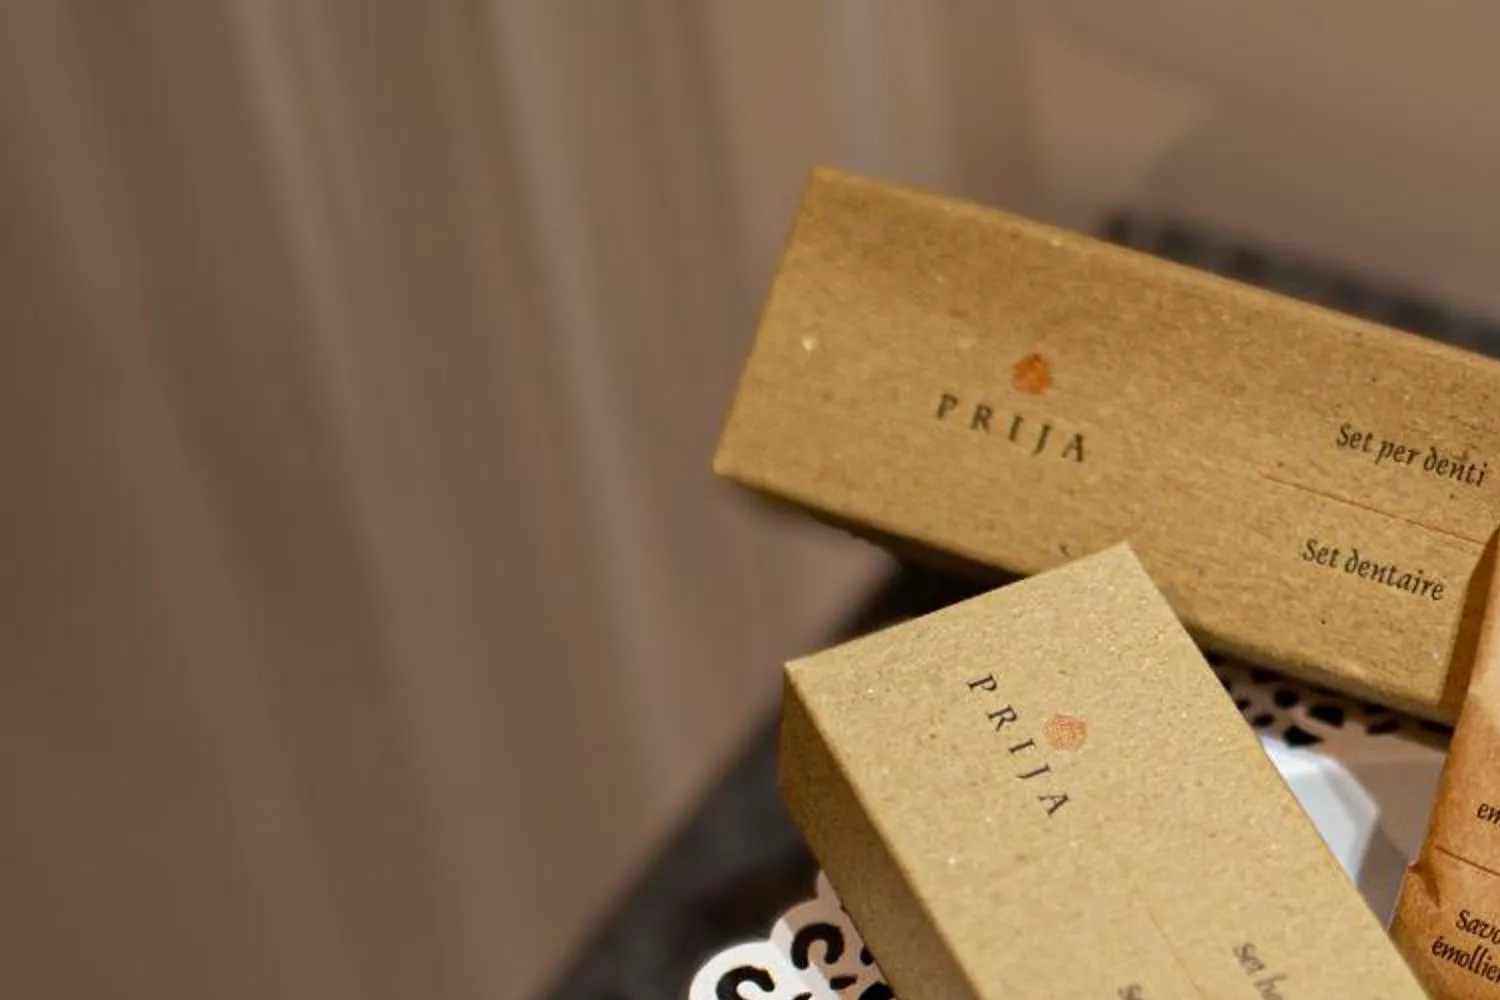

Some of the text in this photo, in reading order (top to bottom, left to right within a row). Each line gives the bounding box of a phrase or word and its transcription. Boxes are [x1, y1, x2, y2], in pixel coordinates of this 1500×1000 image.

[936, 393, 1084, 463] PRIJA
[1336, 422, 1488, 487] Set per denti
[1302, 538, 1444, 601] Set dentaire
[966, 672, 1070, 817] PRIJA
